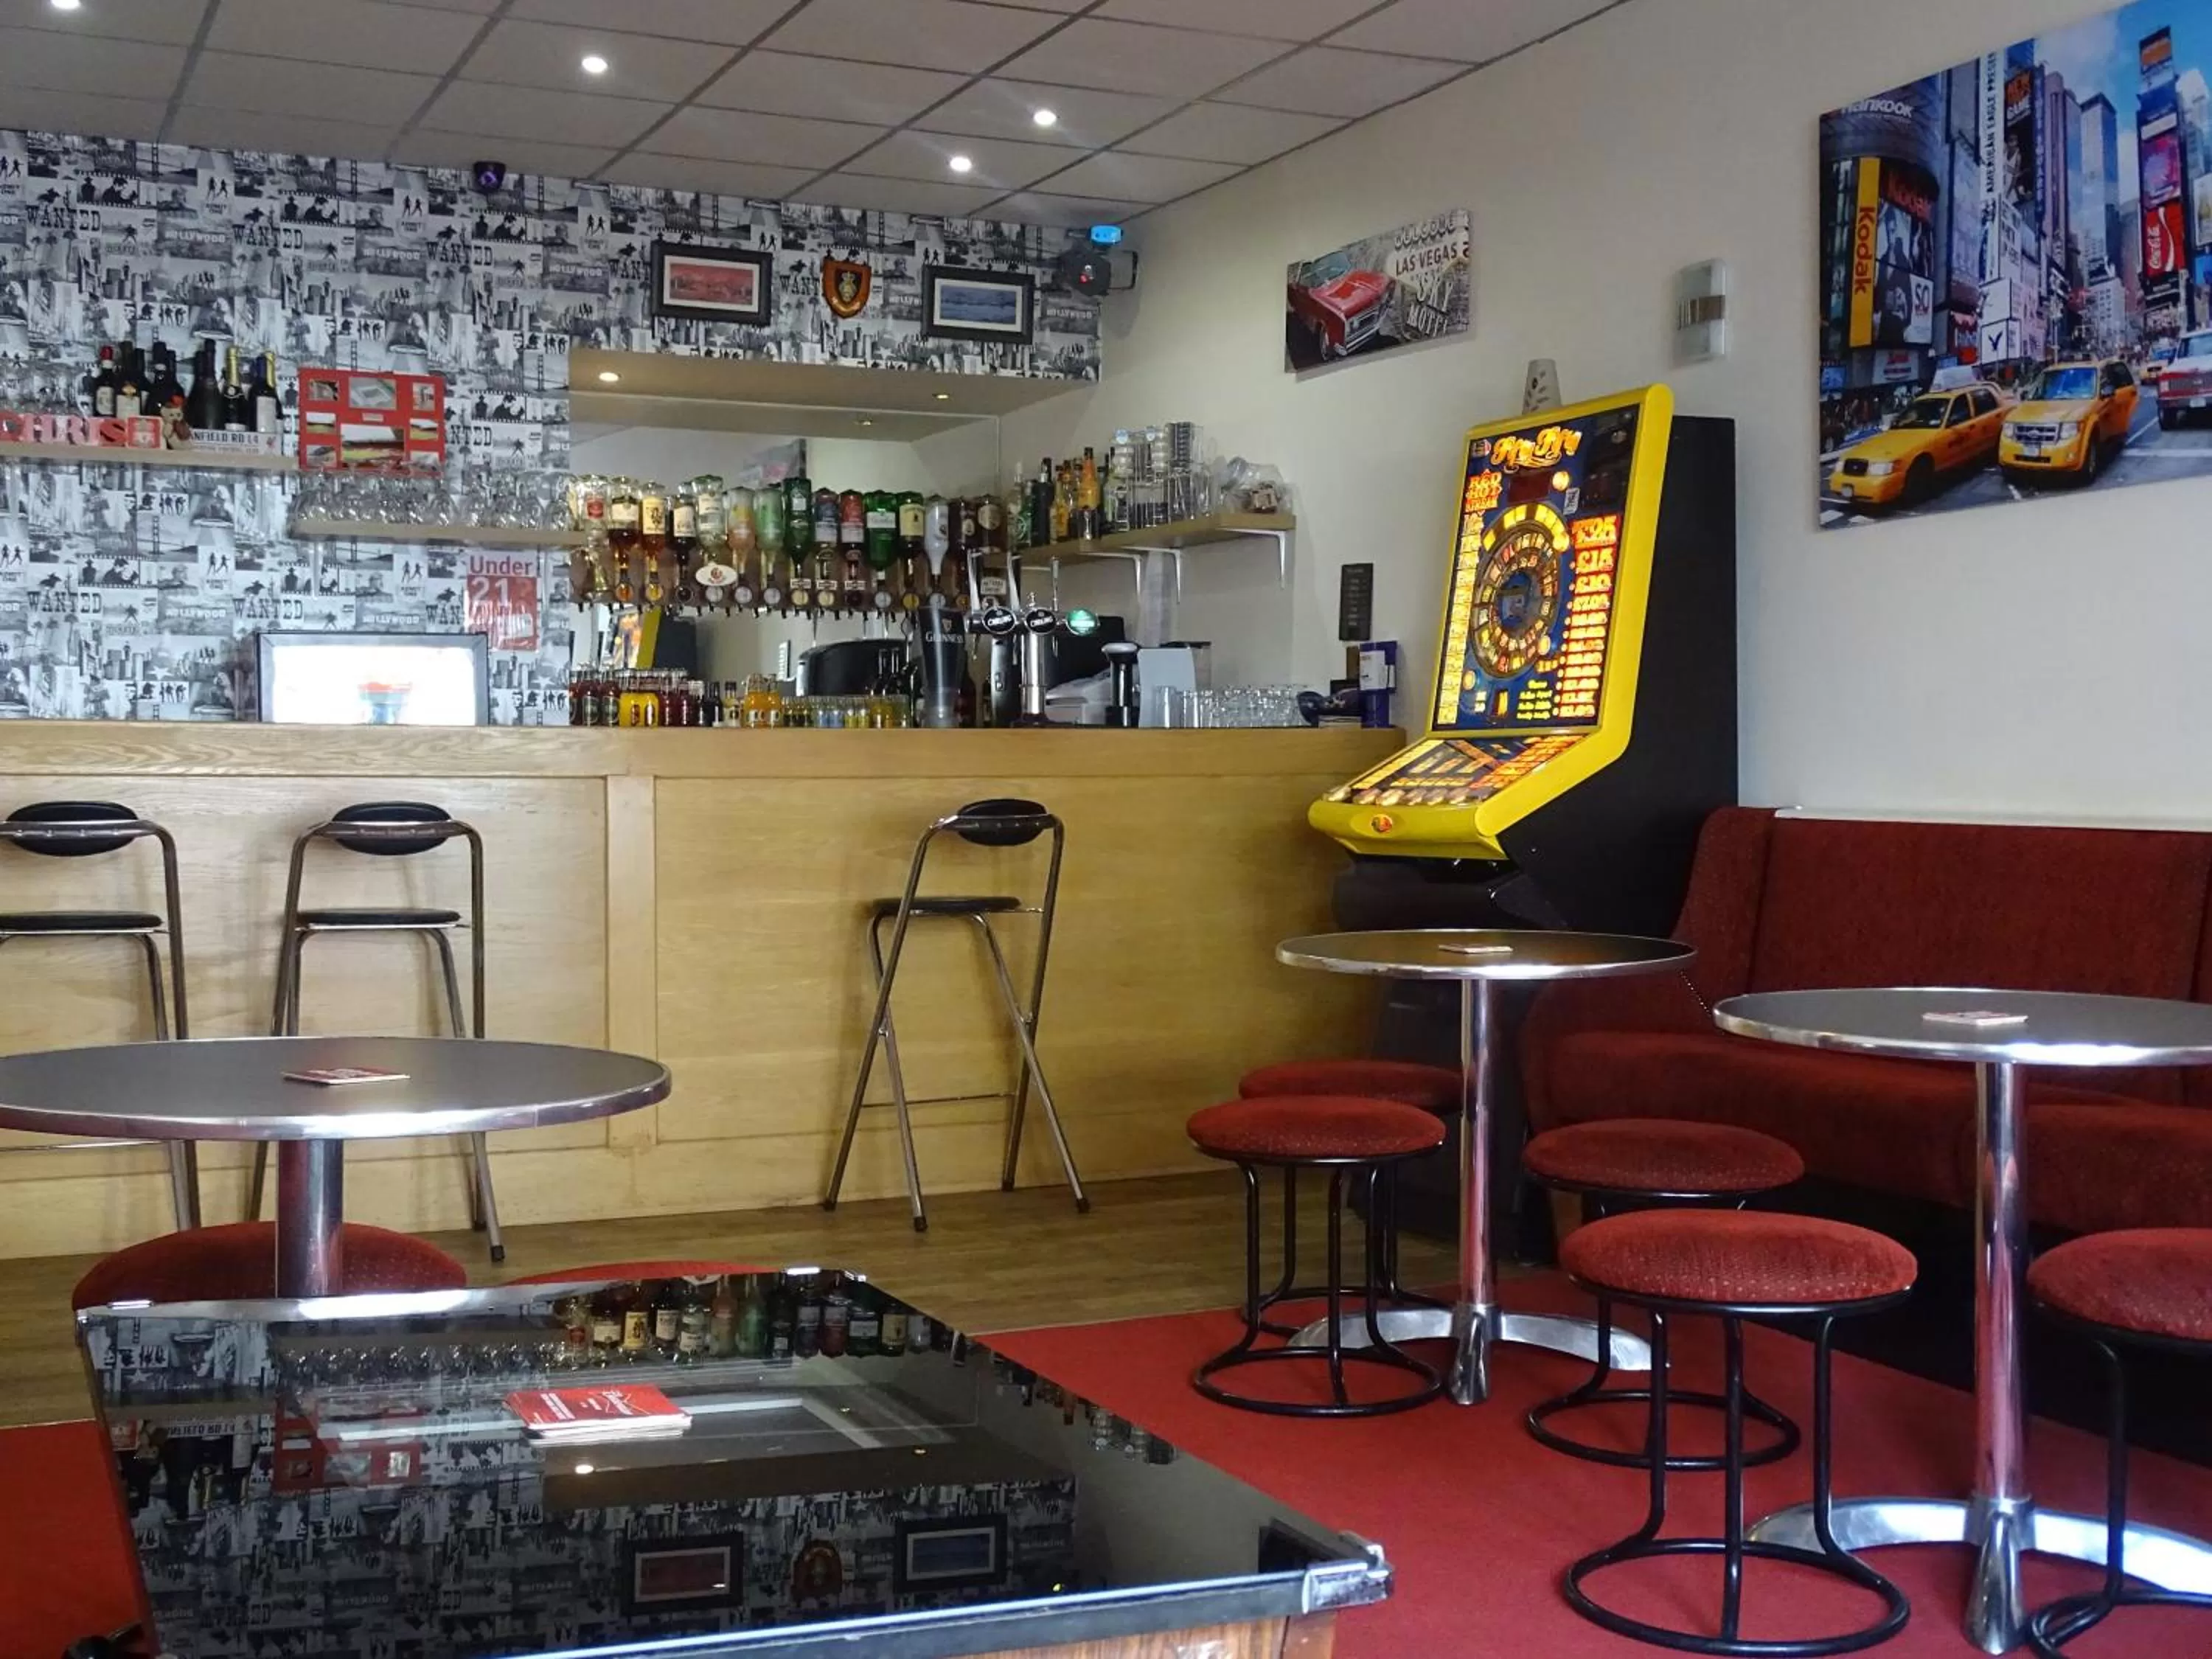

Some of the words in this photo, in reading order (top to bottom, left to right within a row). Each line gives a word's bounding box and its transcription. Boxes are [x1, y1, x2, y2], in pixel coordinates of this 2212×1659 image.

[26, 205, 101, 232] WANTED
[232, 223, 303, 250] WANTED
[1854, 206, 1876, 293] Kodak
[425, 241, 493, 267] WANTED
[1396, 254, 1416, 277] LAS
[1419, 242, 1458, 269] VEGAS
[470, 555, 534, 575] Under
[27, 591, 102, 614] WANTED
[362, 613, 420, 625] HOLLYWOOD
